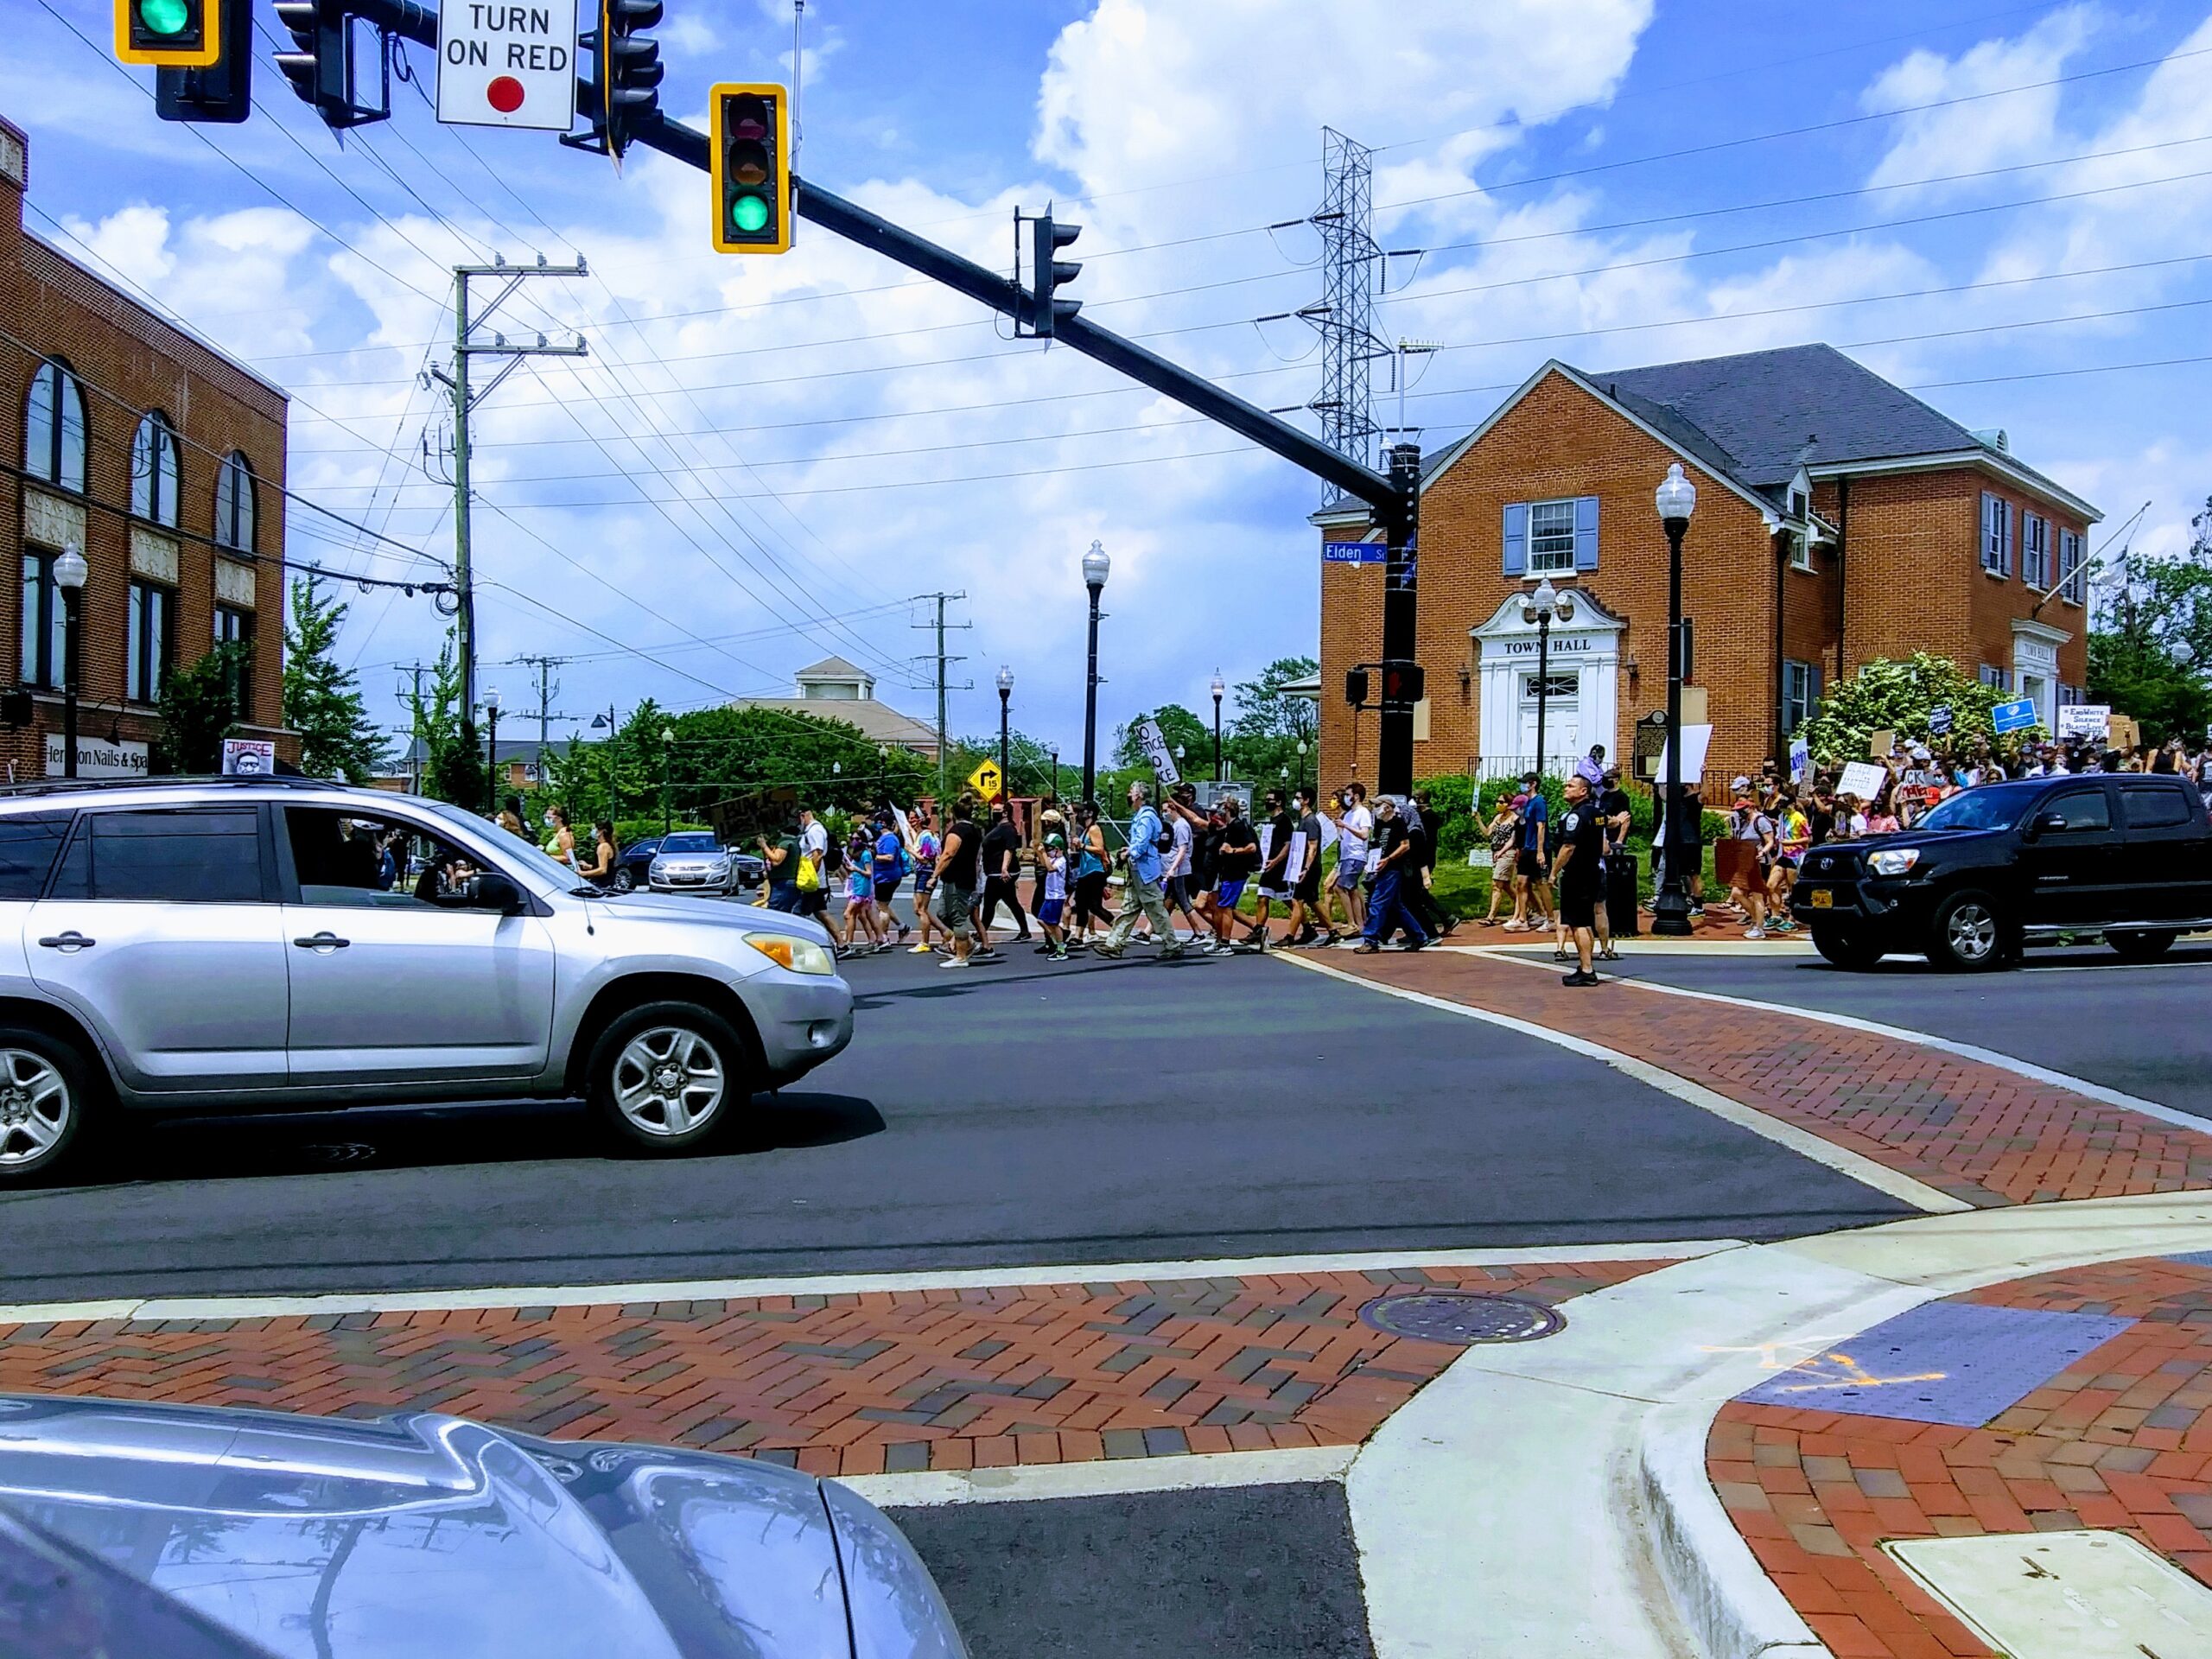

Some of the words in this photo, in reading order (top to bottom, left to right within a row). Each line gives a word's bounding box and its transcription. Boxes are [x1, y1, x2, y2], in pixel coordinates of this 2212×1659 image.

[468, 3, 549, 35] TURN
[447, 39, 487, 67] ON
[507, 42, 568, 71] RED
[1326, 544, 1362, 561] Elden
[1553, 639, 1591, 652] HALL
[226, 741, 272, 757] JUSTICE
[1141, 735, 1166, 753] TICE
[47, 746, 91, 765] Heron
[92, 749, 119, 767] Nails
[121, 752, 129, 767] &
[130, 752, 148, 772] Spa
[1156, 768, 1175, 784] ACE
